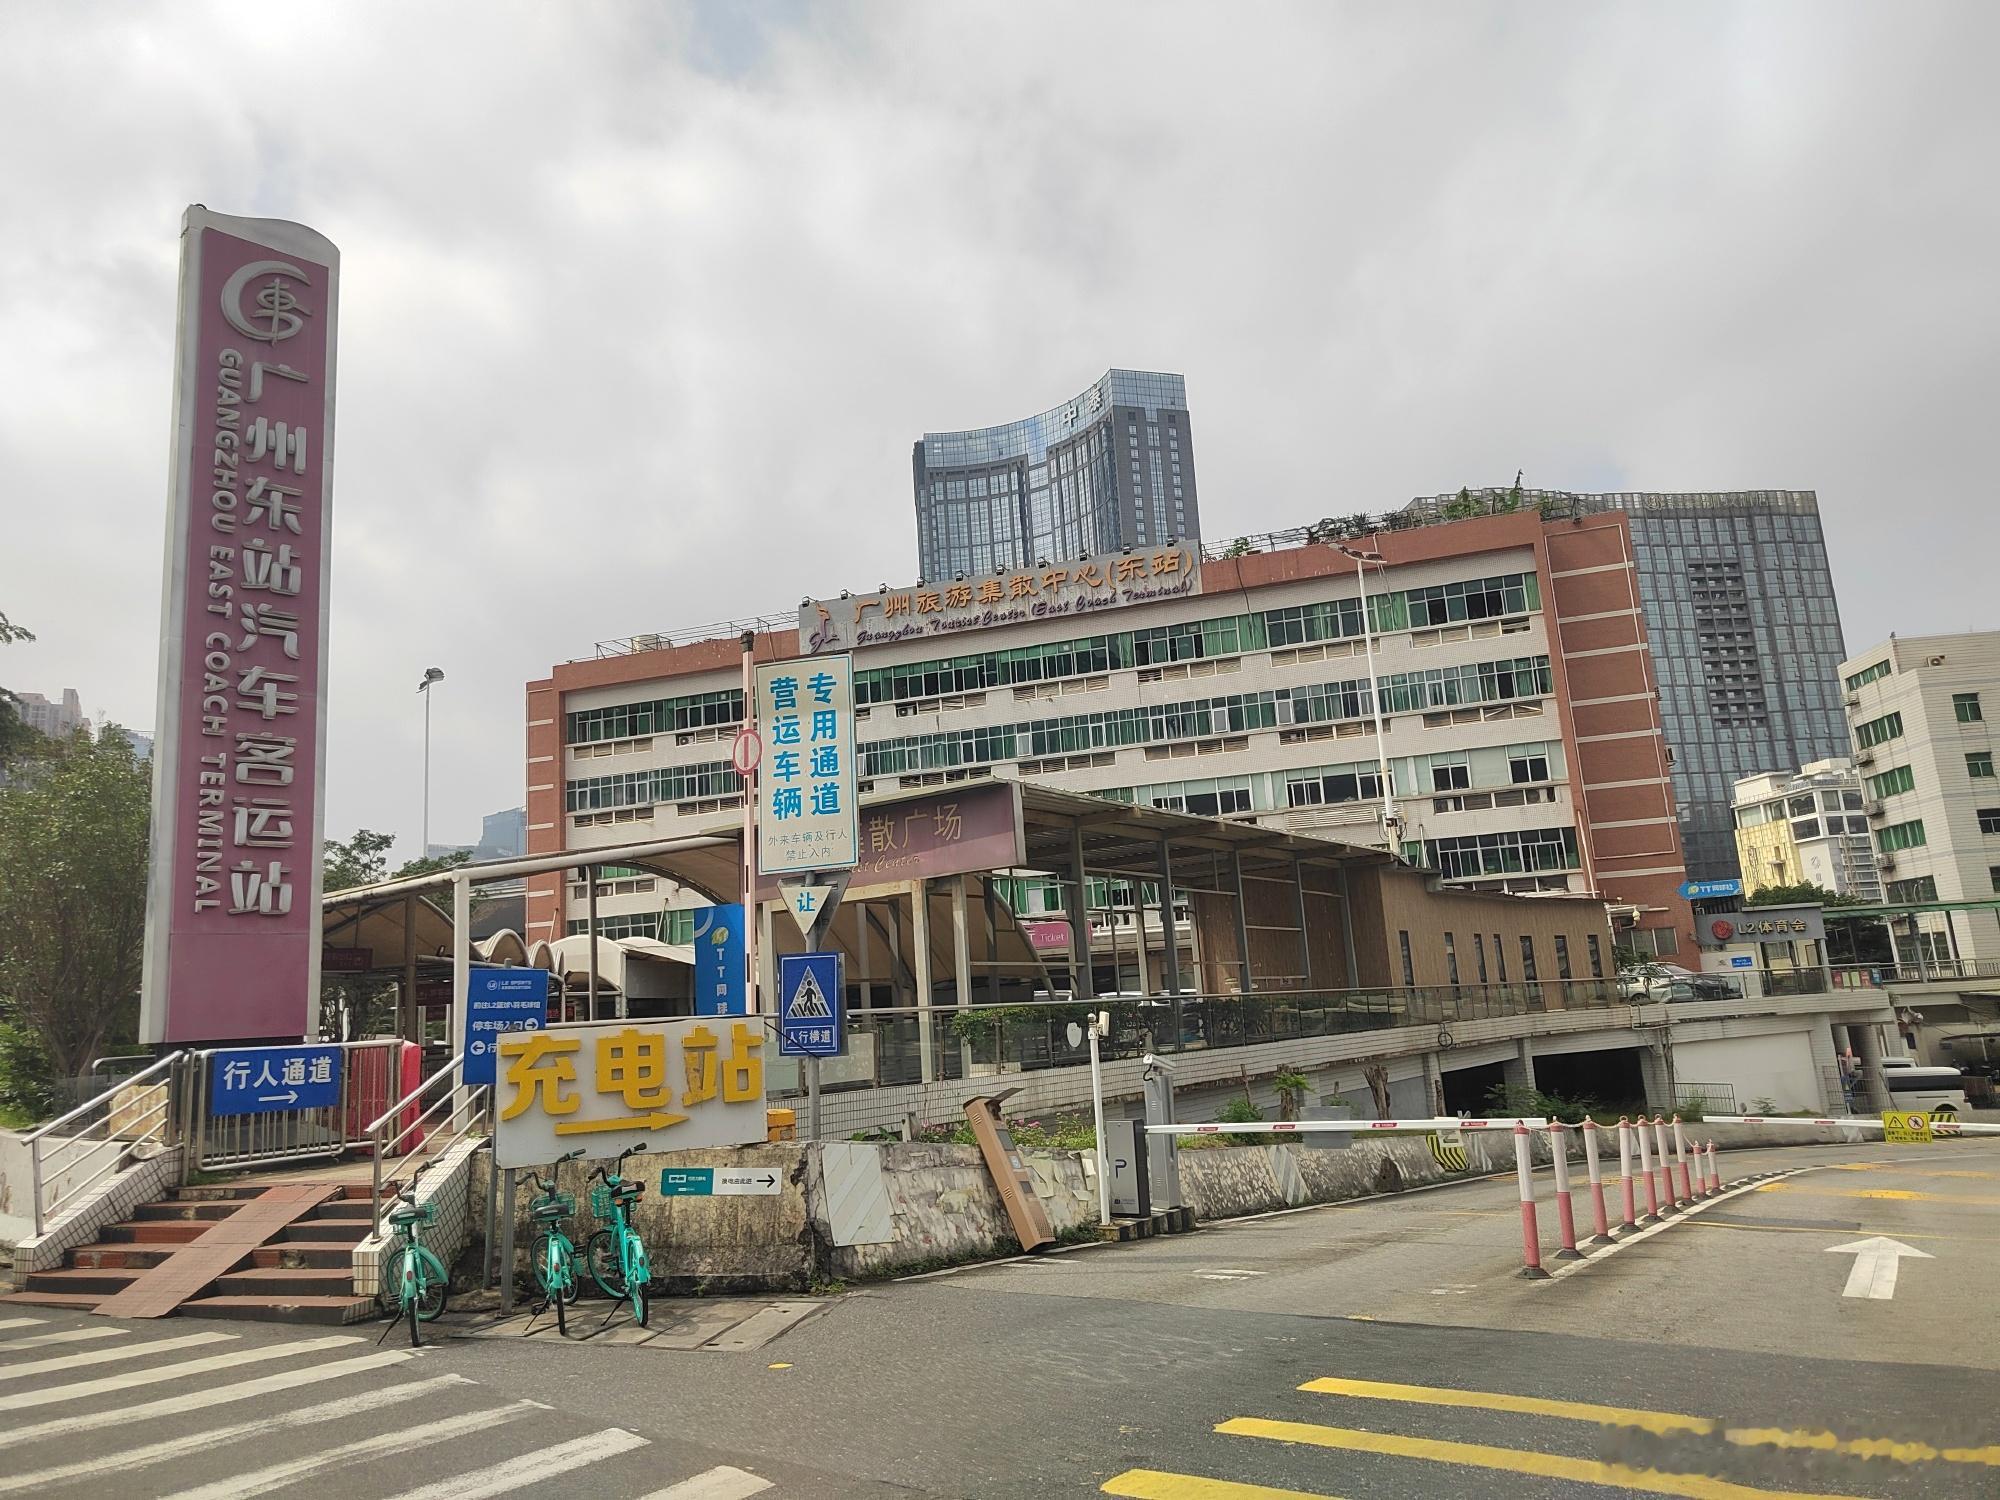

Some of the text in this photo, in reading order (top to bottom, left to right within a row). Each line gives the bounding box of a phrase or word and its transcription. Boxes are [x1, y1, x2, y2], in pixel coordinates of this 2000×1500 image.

[855, 550, 1193, 626] 广州旅游集散中心(东站)
[194, 348, 244, 914] GUANGZHOU EAST COACH TERMINAL
[227, 360, 310, 916] 广州东站汽车客运站
[857, 624, 924, 646] Guangzhou
[930, 614, 982, 631] Tourist
[982, 607, 1027, 626] Center
[1031, 599, 1069, 616] (East
[1075, 592, 1117, 612] Coach
[769, 676, 802, 821] 营运车辆
[806, 671, 842, 817] 专用通道
[768, 827, 848, 847] 外来车辆及行人
[785, 846, 832, 862] 禁止入内
[796, 892, 816, 913] 让
[1737, 918, 1807, 935] L2体育会
[787, 1030, 832, 1045] 人行横道
[223, 1055, 333, 1091] 行人通道
[501, 1023, 764, 1121] 充电站
